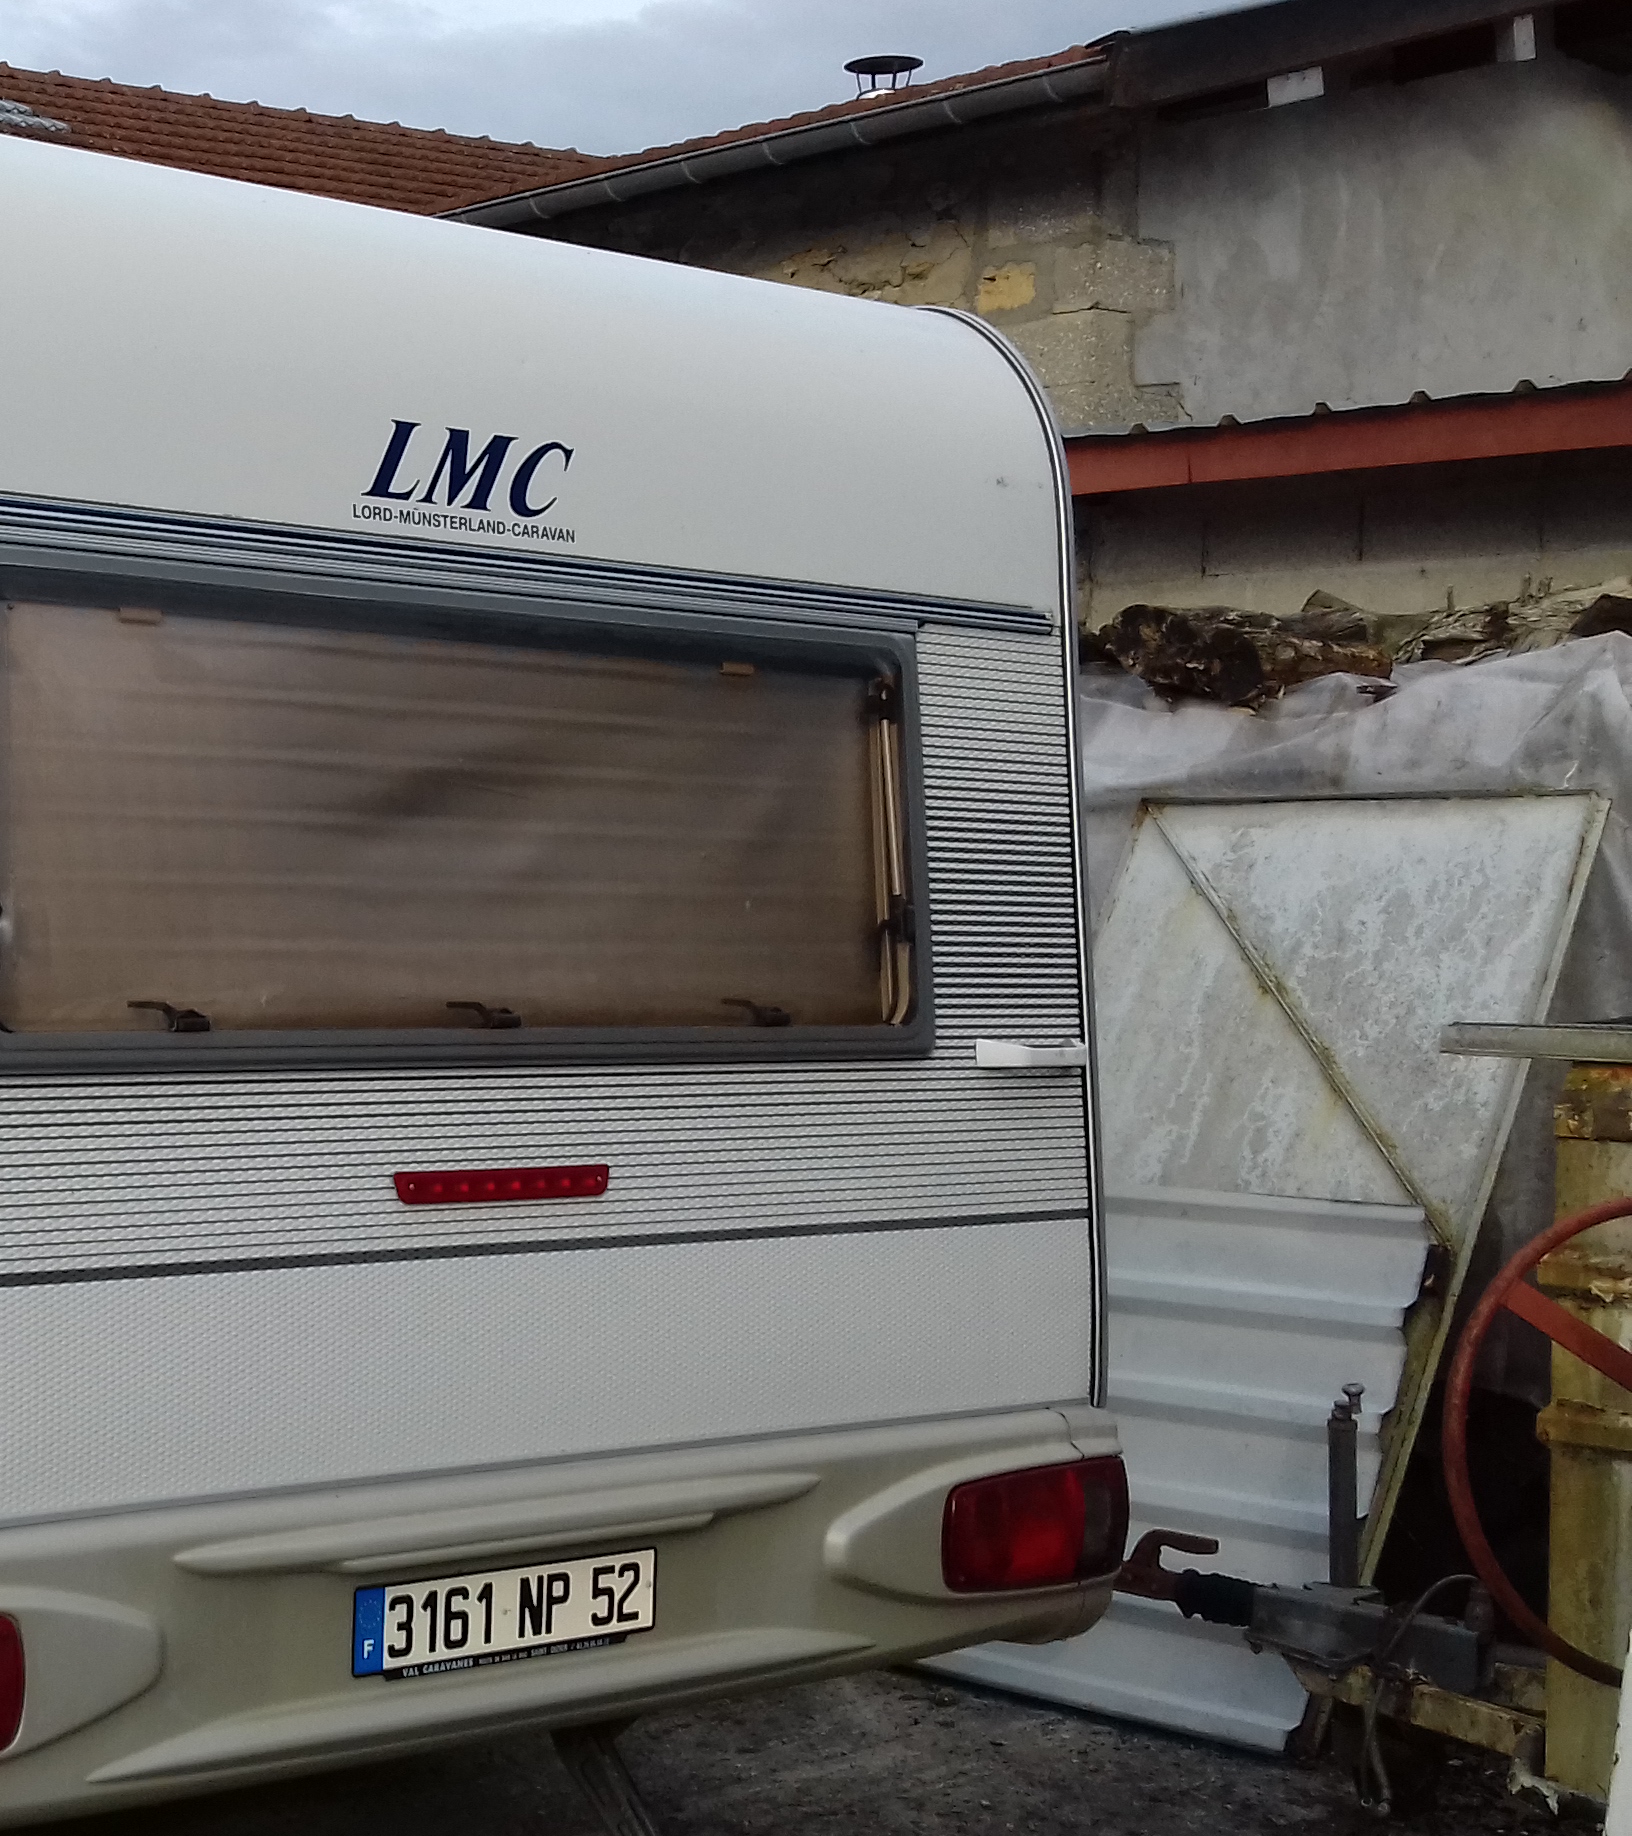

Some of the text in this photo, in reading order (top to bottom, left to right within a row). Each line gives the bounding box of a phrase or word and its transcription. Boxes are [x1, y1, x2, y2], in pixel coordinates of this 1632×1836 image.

[360, 418, 574, 518] LMC
[352, 503, 576, 544] LORD-MÜNSTERLAND-CARAVAN
[386, 1561, 641, 1659] 3161 NP 52
[362, 1638, 375, 1660] F
[402, 1666, 420, 1678] VAL
[422, 1657, 474, 1674] CARAVANES
